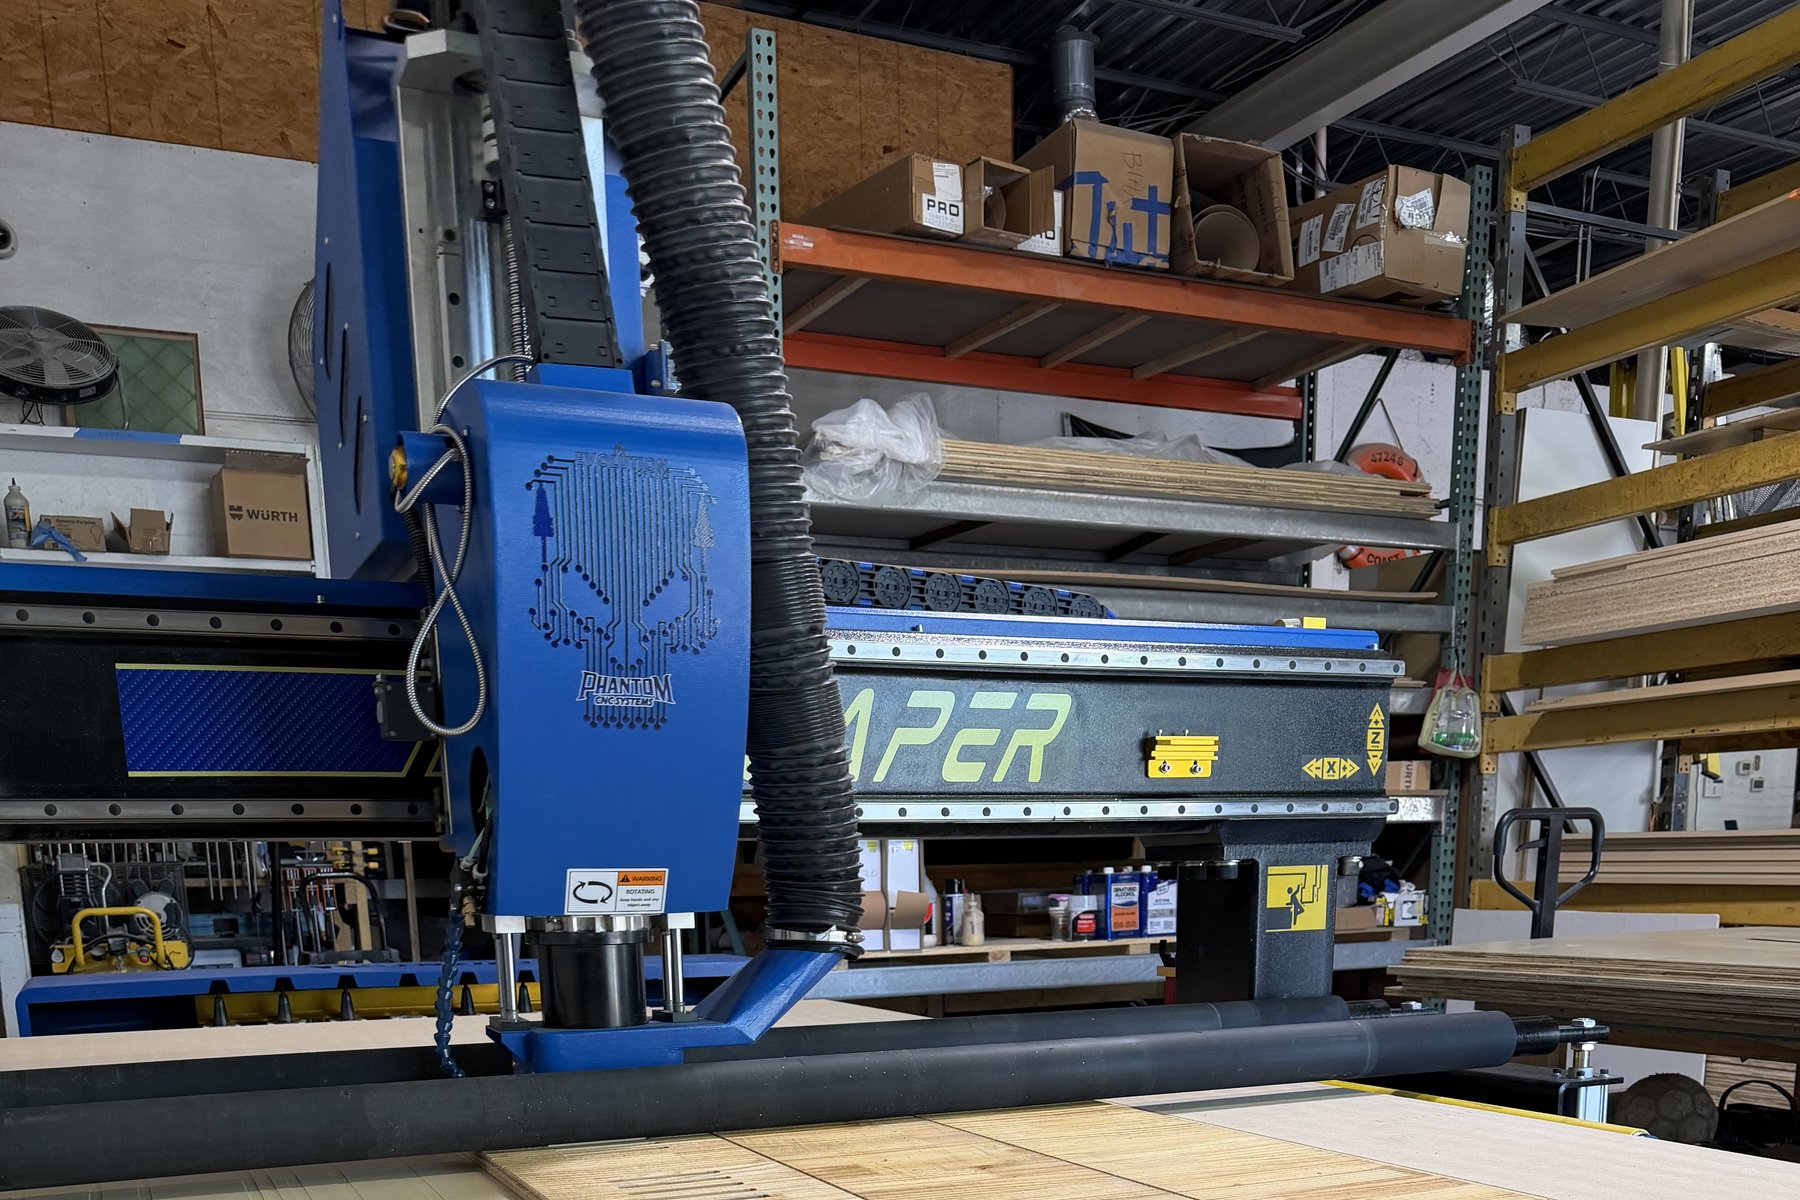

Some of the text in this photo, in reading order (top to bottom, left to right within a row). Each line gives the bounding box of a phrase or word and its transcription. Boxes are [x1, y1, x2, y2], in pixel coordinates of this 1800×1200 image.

[926, 198, 960, 218] PRO
[246, 508, 298, 523] WÜRTH
[577, 670, 676, 704] PHANTOM
[1371, 731, 1381, 744] Z
[1326, 761, 1337, 774] X
